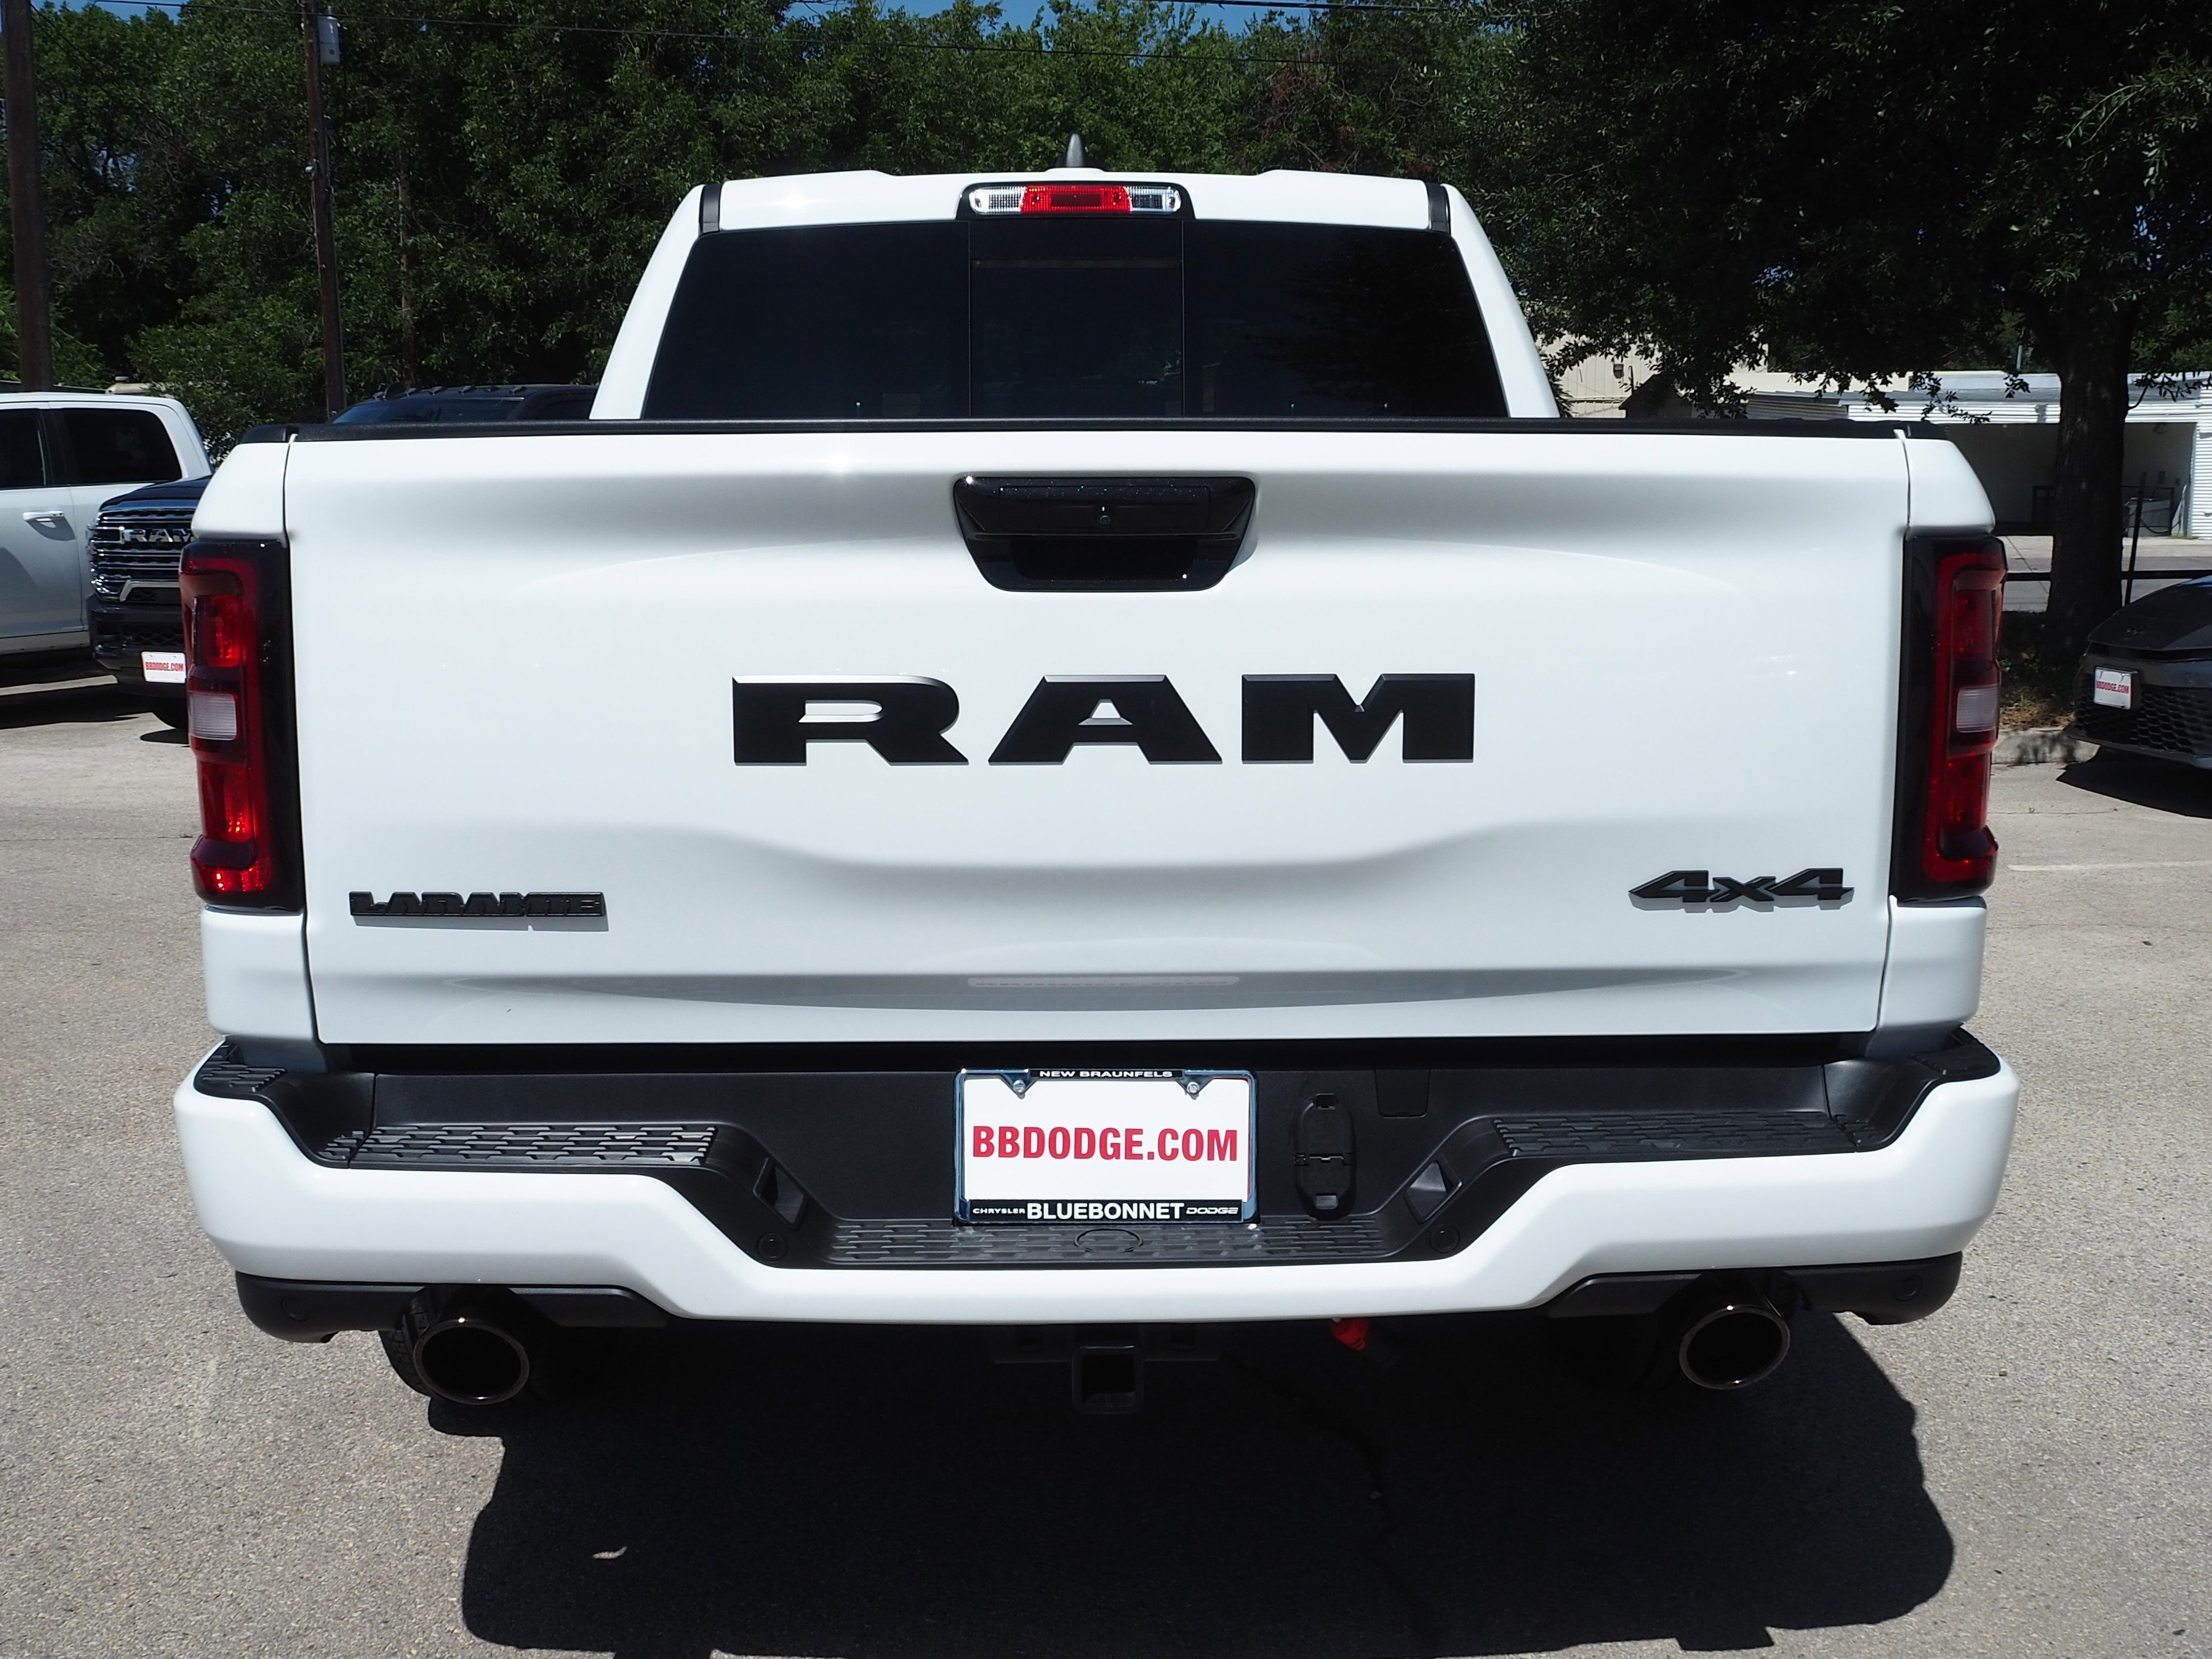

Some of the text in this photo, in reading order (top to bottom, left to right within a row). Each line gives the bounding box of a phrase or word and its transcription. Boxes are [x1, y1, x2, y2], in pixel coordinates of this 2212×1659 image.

[732, 674, 1475, 766] RAM
[349, 891, 605, 916] LARAMIE
[1628, 868, 1854, 904] 4x4
[972, 1125, 1238, 1162] BBDODGE.COM
[1027, 1203, 1184, 1220] BLUEBONNET
[1186, 1207, 1239, 1215] DODGE
